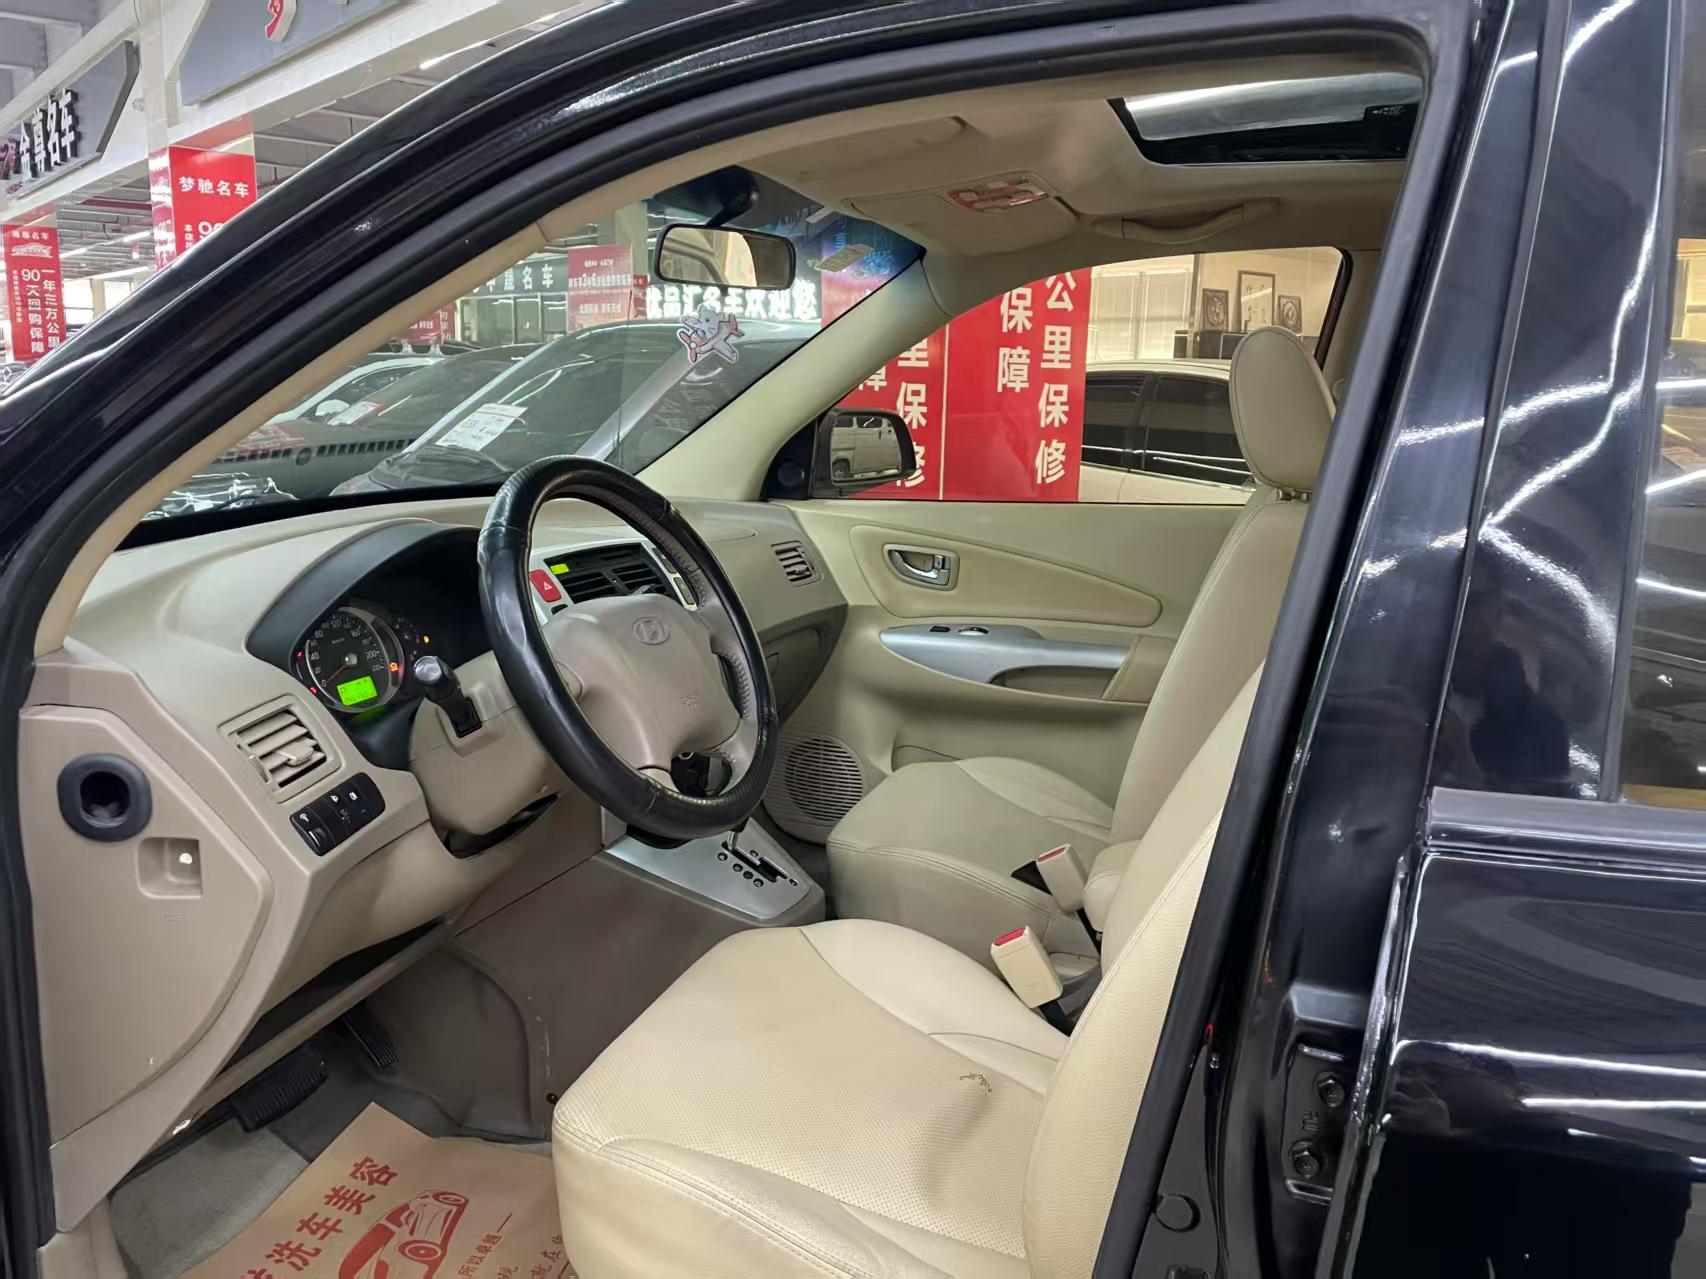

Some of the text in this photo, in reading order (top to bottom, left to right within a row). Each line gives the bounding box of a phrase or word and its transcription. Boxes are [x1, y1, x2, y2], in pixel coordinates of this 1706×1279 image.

[179, 176, 249, 198] 梦驰名车
[997, 287, 1033, 393] 保障
[1035, 272, 1077, 485] 公里保修
